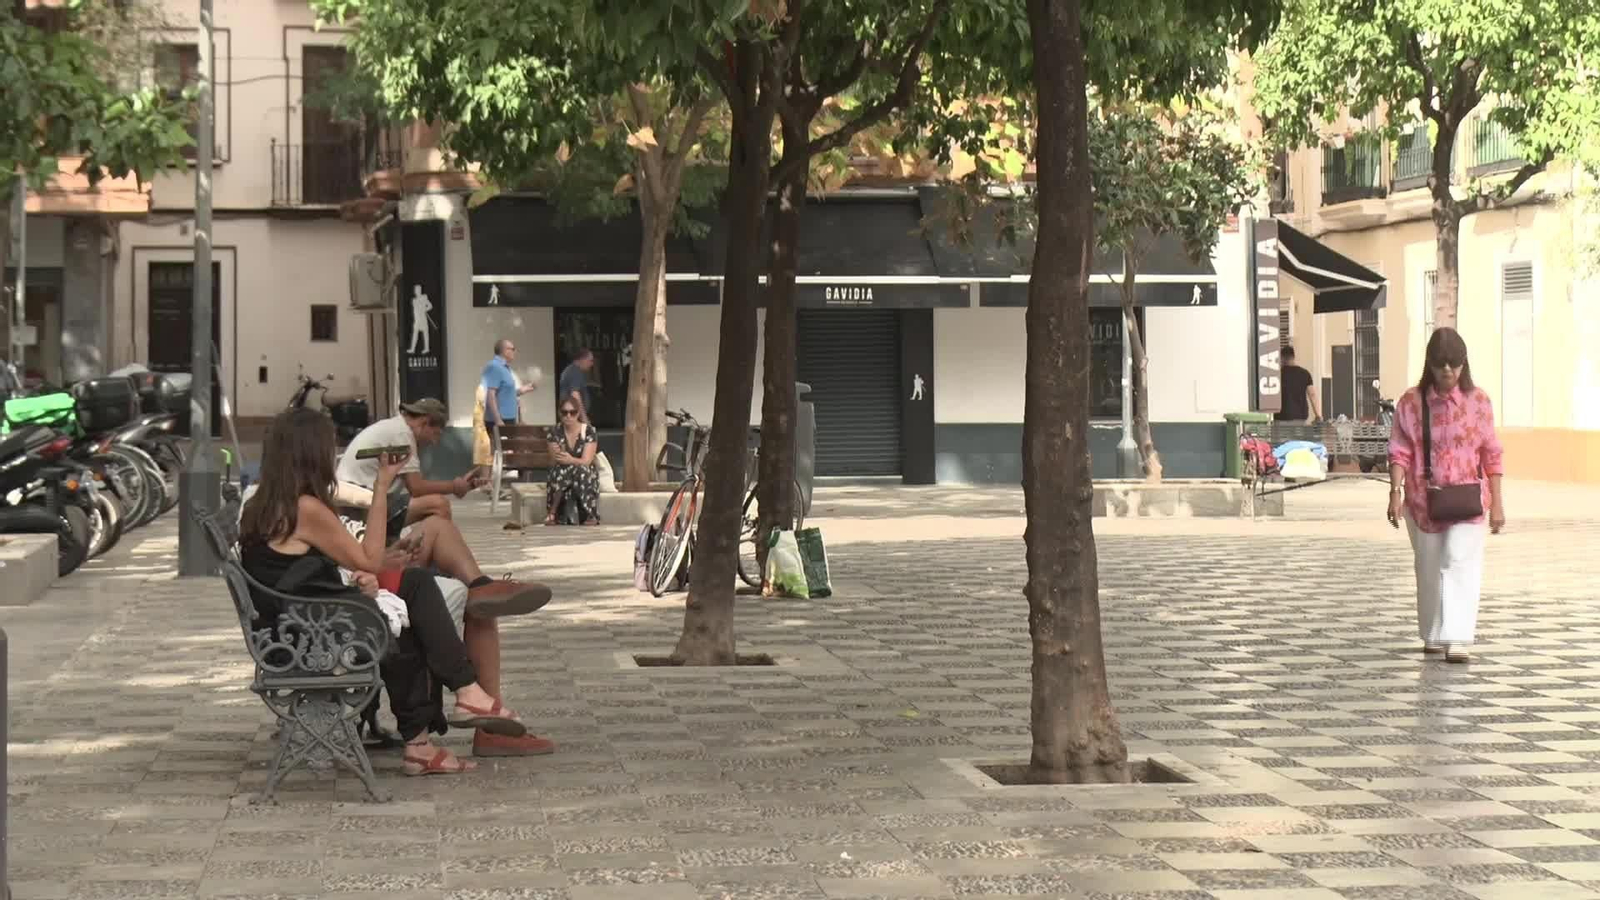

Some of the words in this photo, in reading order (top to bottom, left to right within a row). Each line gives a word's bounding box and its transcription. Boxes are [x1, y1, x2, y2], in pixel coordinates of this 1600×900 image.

[826, 286, 873, 300] GAVIDIA
[1256, 237, 1280, 395] GAVIDIA
[408, 356, 438, 368] GAVIDIA
